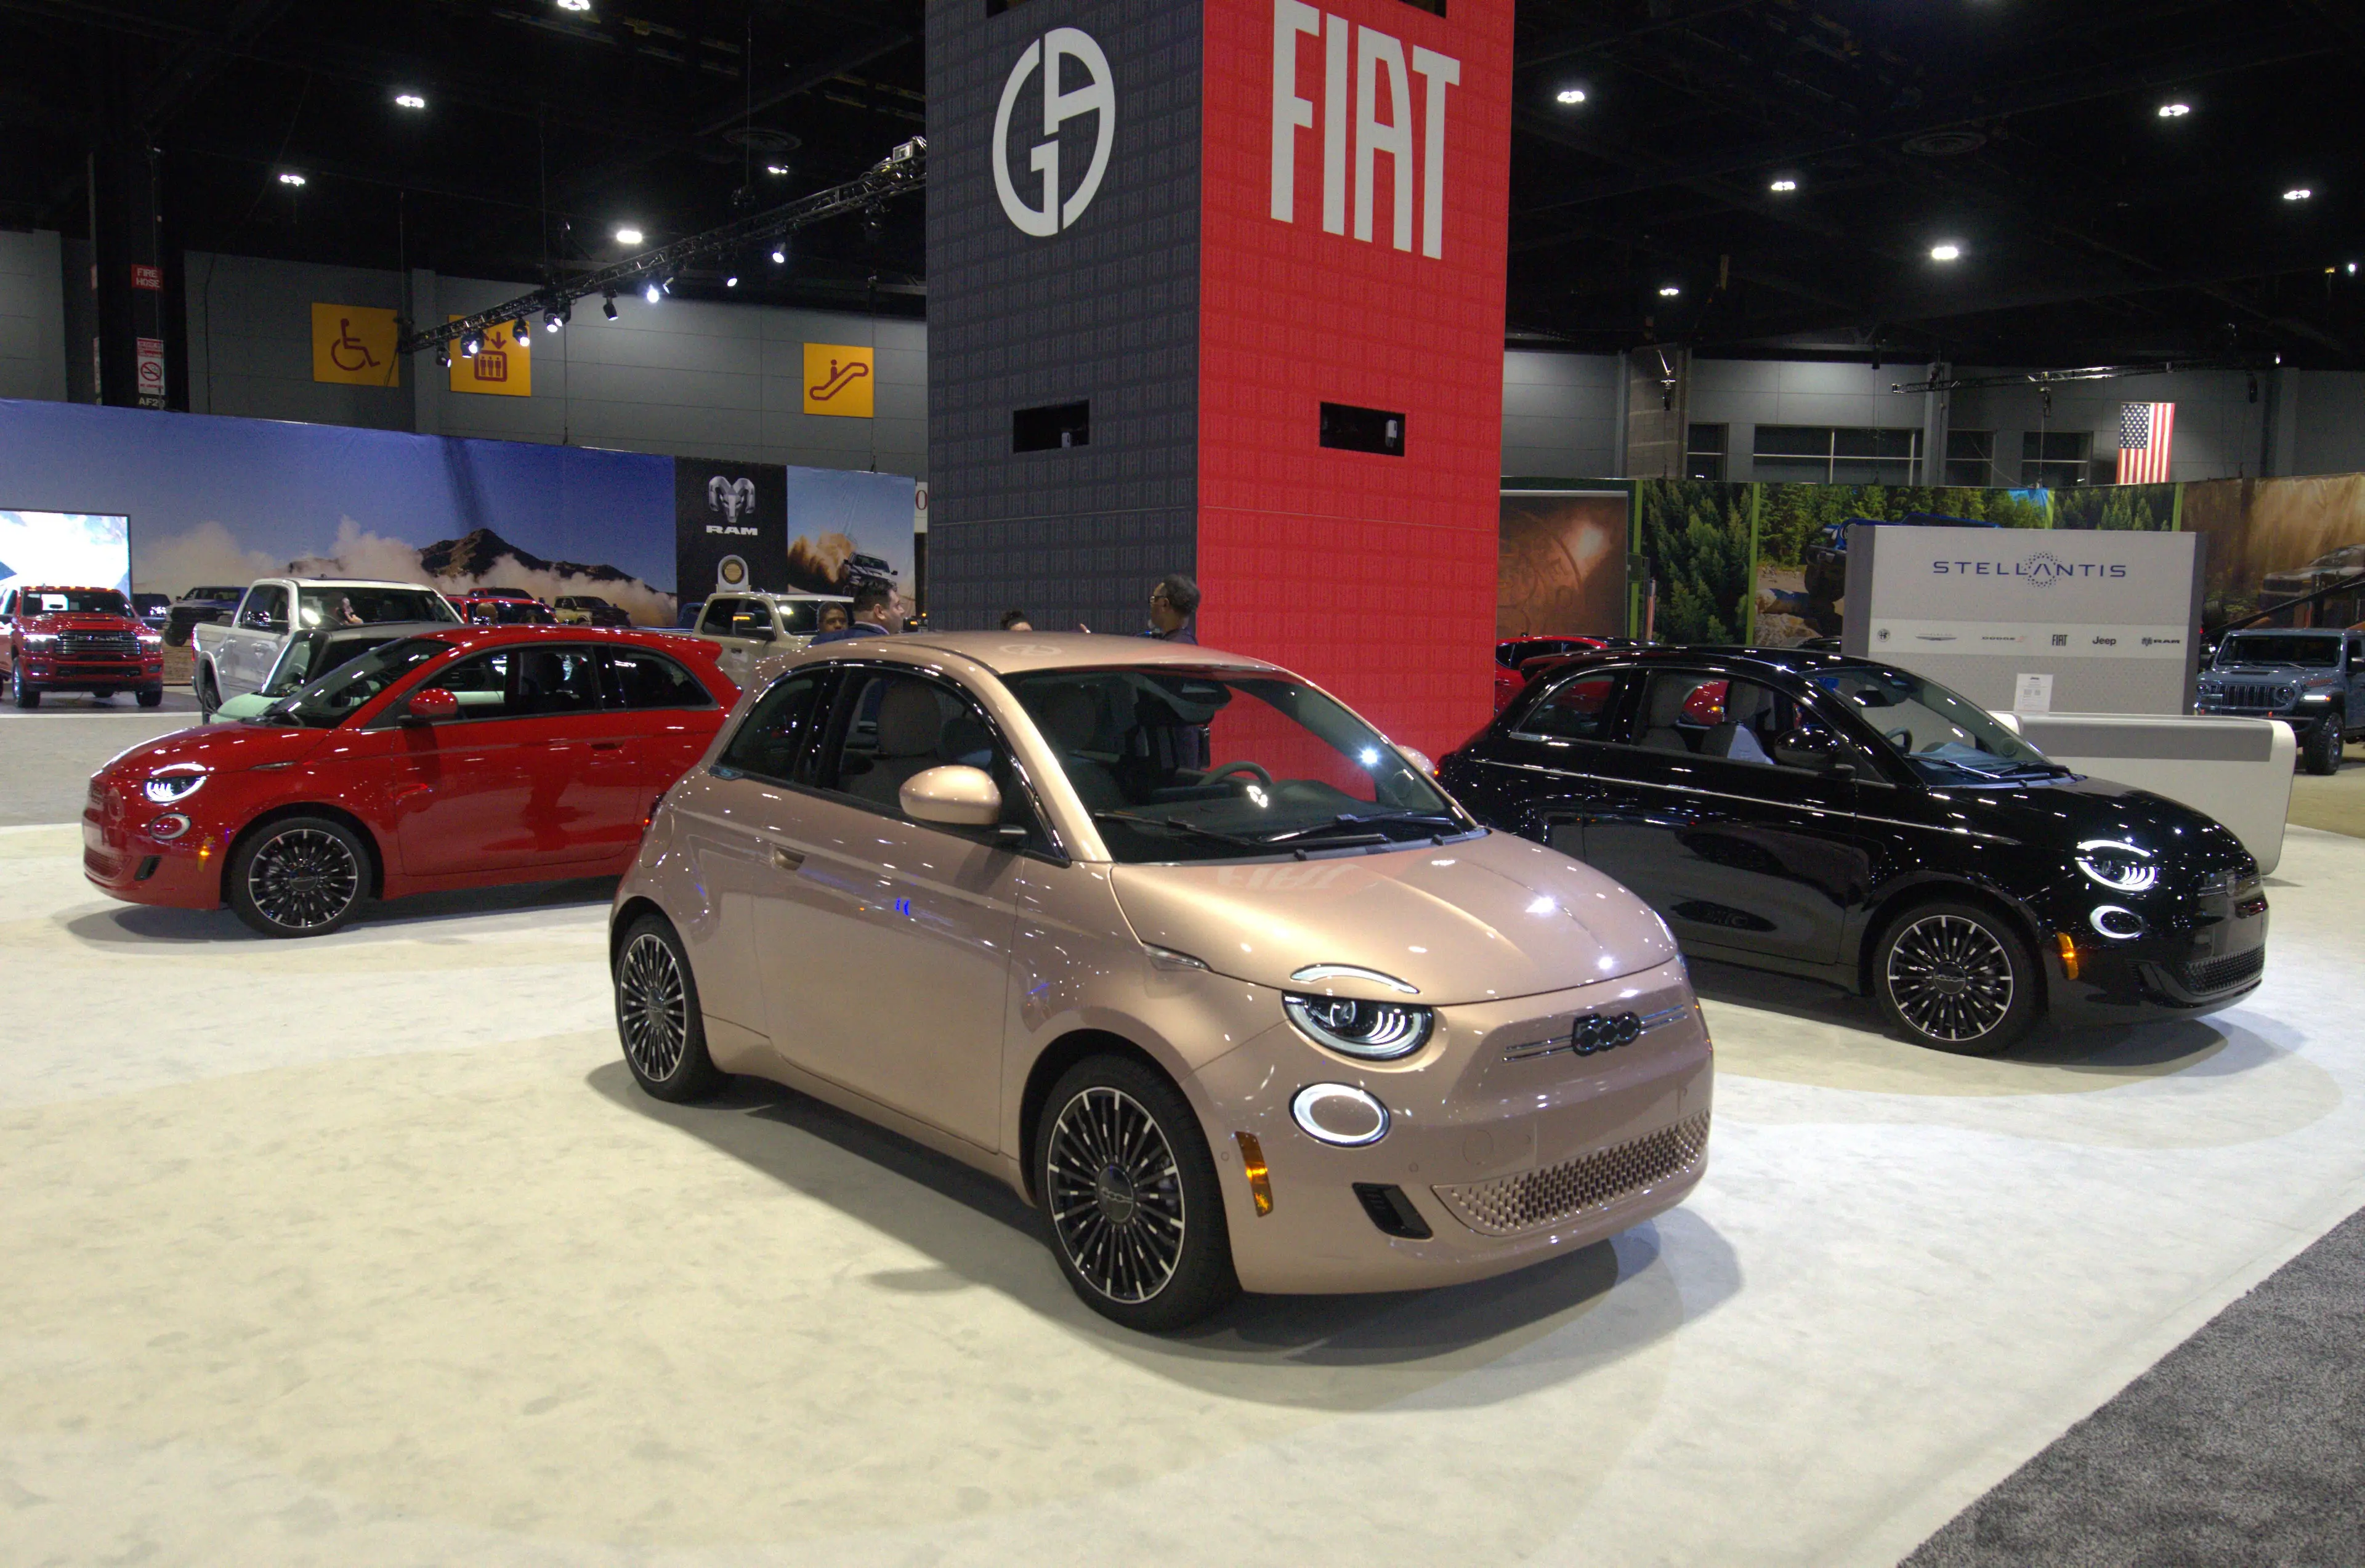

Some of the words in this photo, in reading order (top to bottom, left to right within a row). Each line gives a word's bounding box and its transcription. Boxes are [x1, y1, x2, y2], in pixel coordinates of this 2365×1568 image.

[1271, 0, 1460, 260] FIAT
[137, 267, 158, 278] FIRE
[135, 277, 160, 288] HOSE
[706, 525, 758, 536] RAM
[1933, 561, 2127, 578] STELLANTIS
[2052, 634, 2068, 647] FIAT
[2092, 636, 2117, 647] Jeep
[1571, 1011, 1641, 1057] 500
